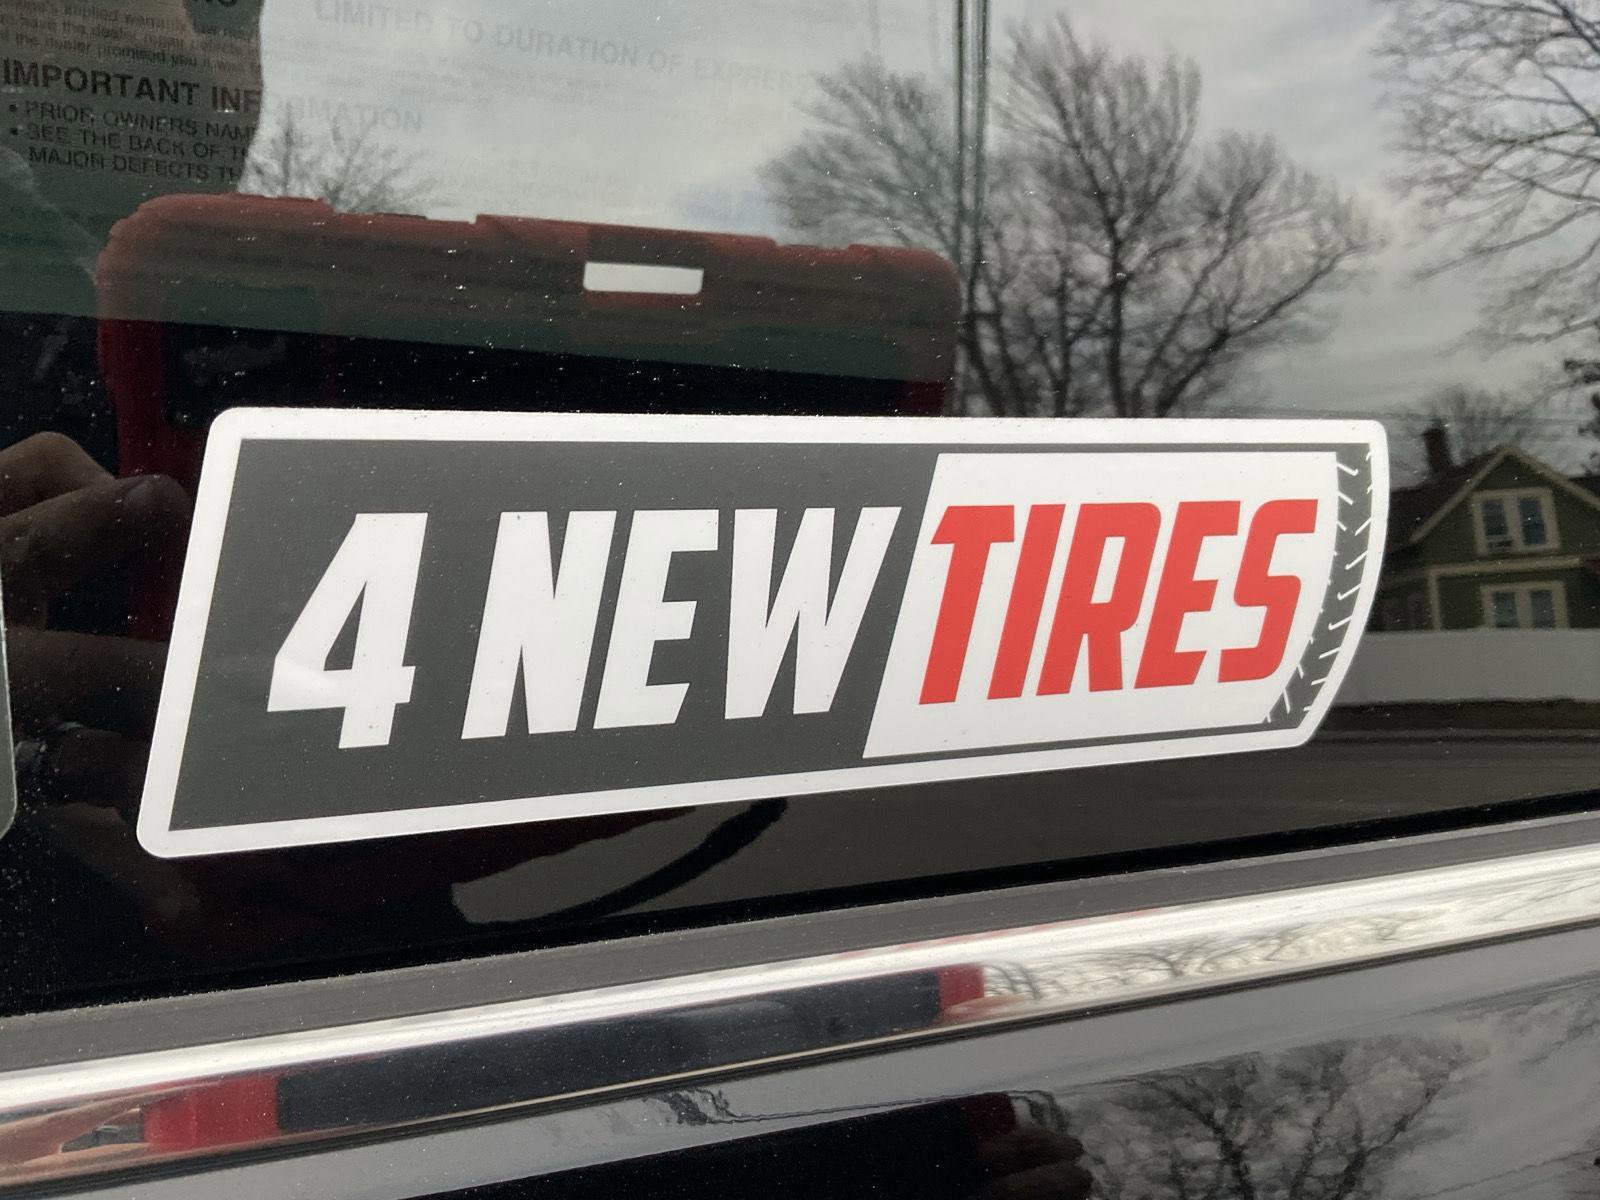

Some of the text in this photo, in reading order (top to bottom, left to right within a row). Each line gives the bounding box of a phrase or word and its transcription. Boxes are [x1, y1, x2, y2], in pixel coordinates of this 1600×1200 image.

[315, 0, 434, 35] LIMITED
[448, 15, 485, 45] TO
[497, 24, 638, 68] DURATION
[649, 49, 683, 73] OF
[3, 57, 200, 106] IMPORTANT
[26, 100, 95, 123] PRIOR
[102, 110, 198, 137] OWNERS
[26, 123, 71, 144] SEE
[80, 128, 122, 151] THE
[129, 134, 186, 157] BACK
[193, 142, 219, 160] OF
[28, 145, 105, 170] MAJOR
[113, 154, 209, 181] DEFECTS
[267, 499, 1319, 748] 4 NEW TIRES
